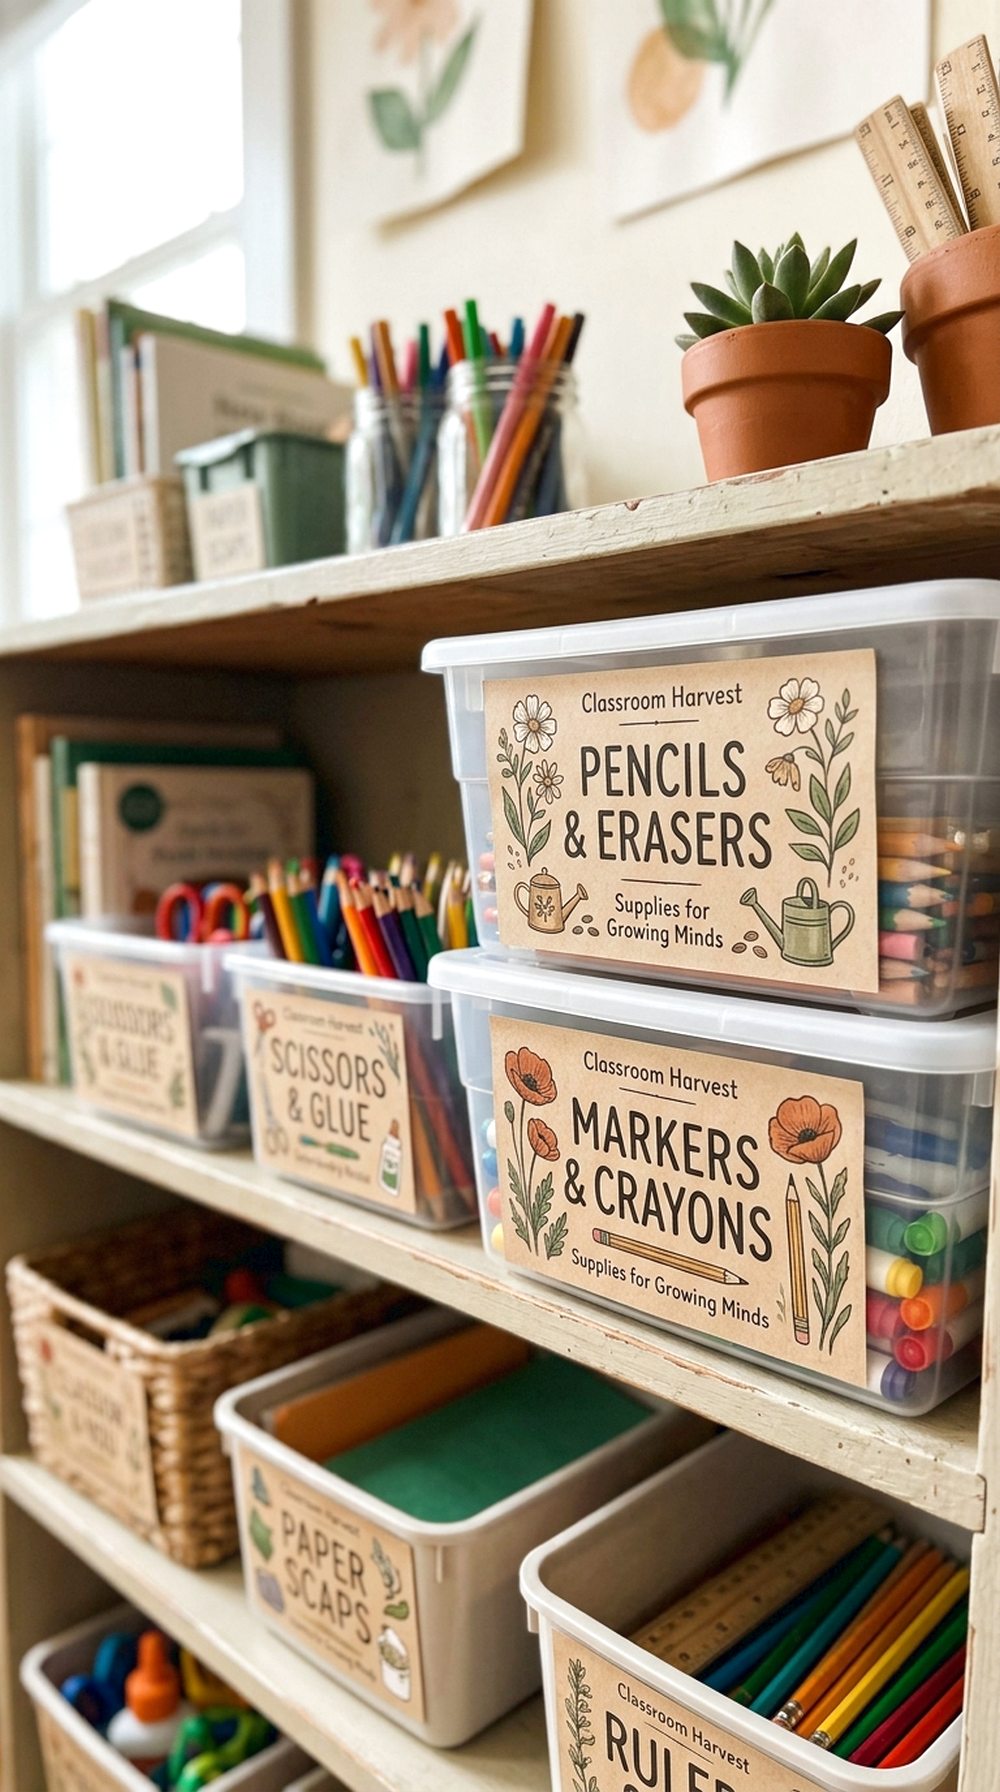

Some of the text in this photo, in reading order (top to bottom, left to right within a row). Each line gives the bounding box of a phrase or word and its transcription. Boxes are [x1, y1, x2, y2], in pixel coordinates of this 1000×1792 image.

[582, 683, 743, 714] Classroom Harvest
[580, 740, 746, 798] PENCILS
[564, 809, 772, 869] & ERASERS
[607, 918, 723, 948] Growing Minds
[615, 893, 709, 920] Supplies for
[271, 1037, 386, 1098] SCISSORS
[583, 1050, 738, 1099] Classroom Harvest
[288, 1087, 371, 1143] & GLUE
[572, 1097, 760, 1191] MARKERS
[564, 1158, 772, 1263] & CRAYONS
[571, 1248, 770, 1329] Supplies for Growing Minds
[281, 1511, 367, 1598] PAPER
[285, 1558, 372, 1645] SCAPS
[617, 1682, 750, 1775] Classroom Harvest
